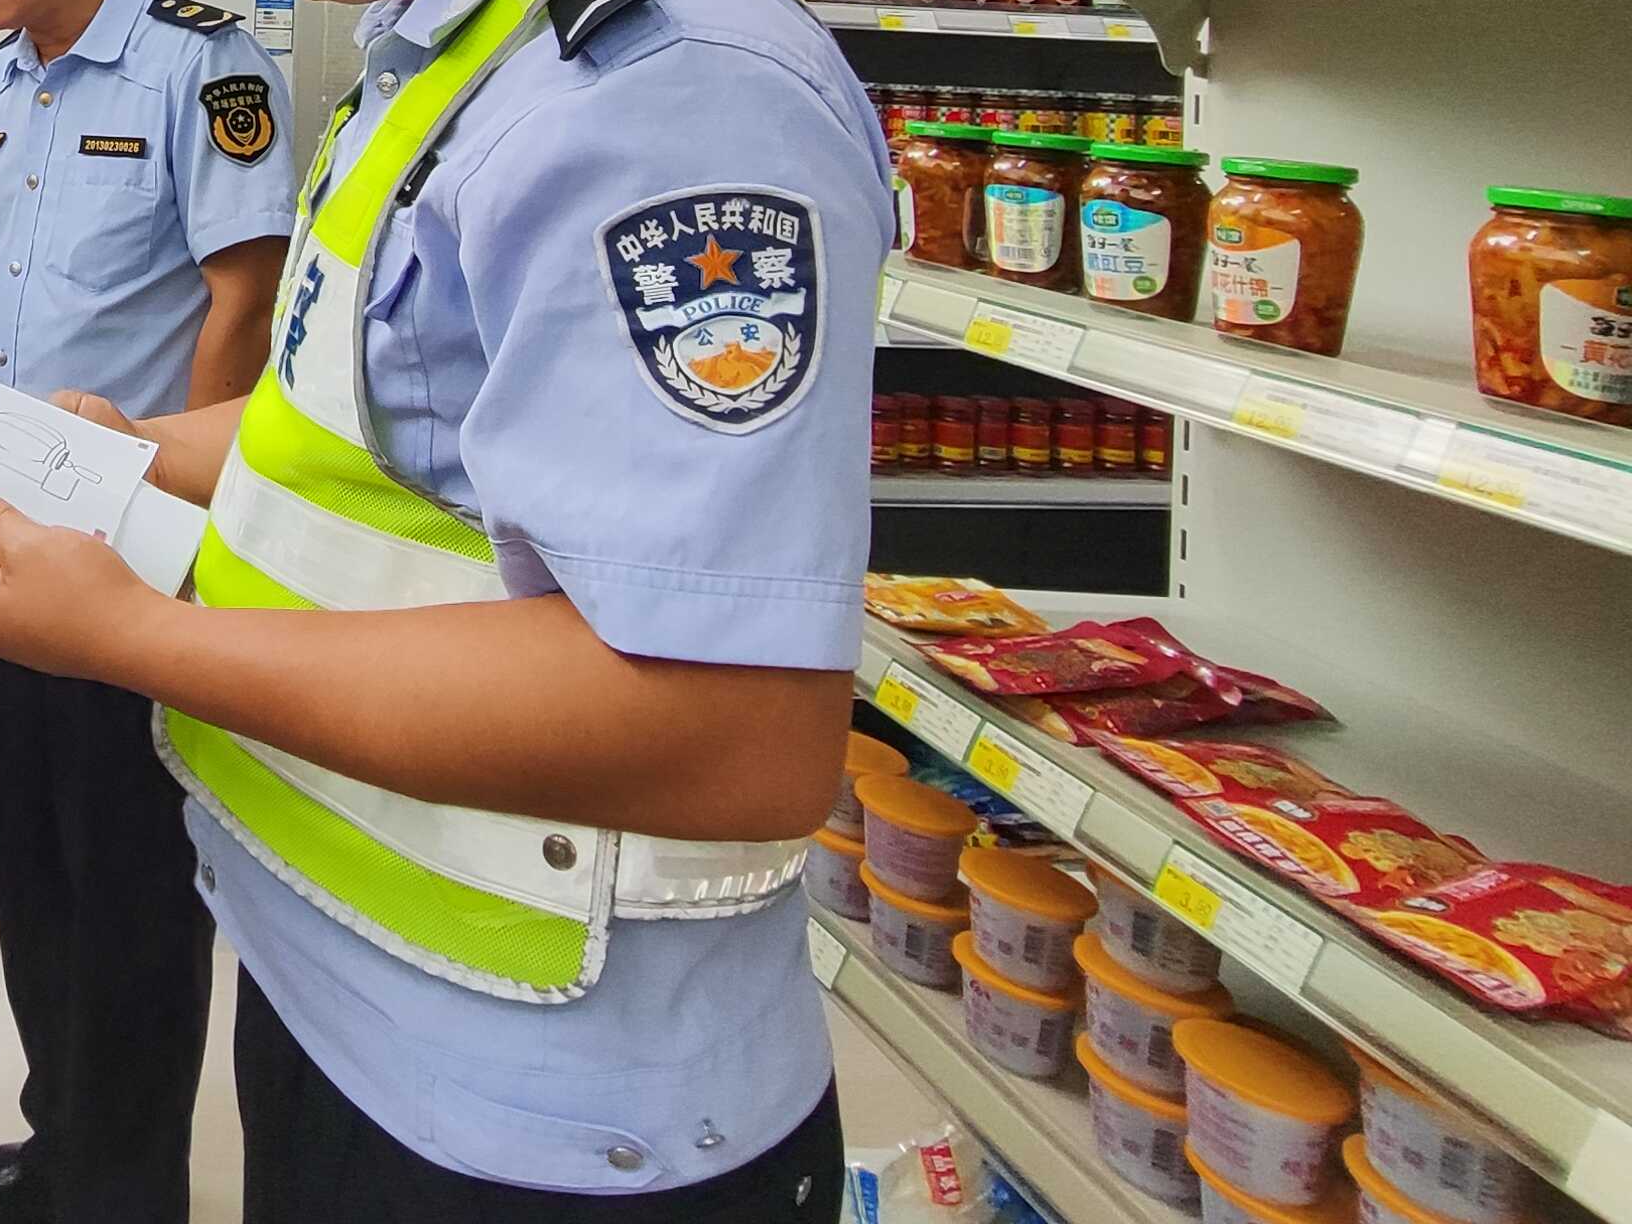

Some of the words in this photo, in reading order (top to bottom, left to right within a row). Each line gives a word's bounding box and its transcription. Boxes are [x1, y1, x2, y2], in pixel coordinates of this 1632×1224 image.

[616, 198, 800, 263] 中华人民共和国
[682, 294, 765, 322] POLICE
